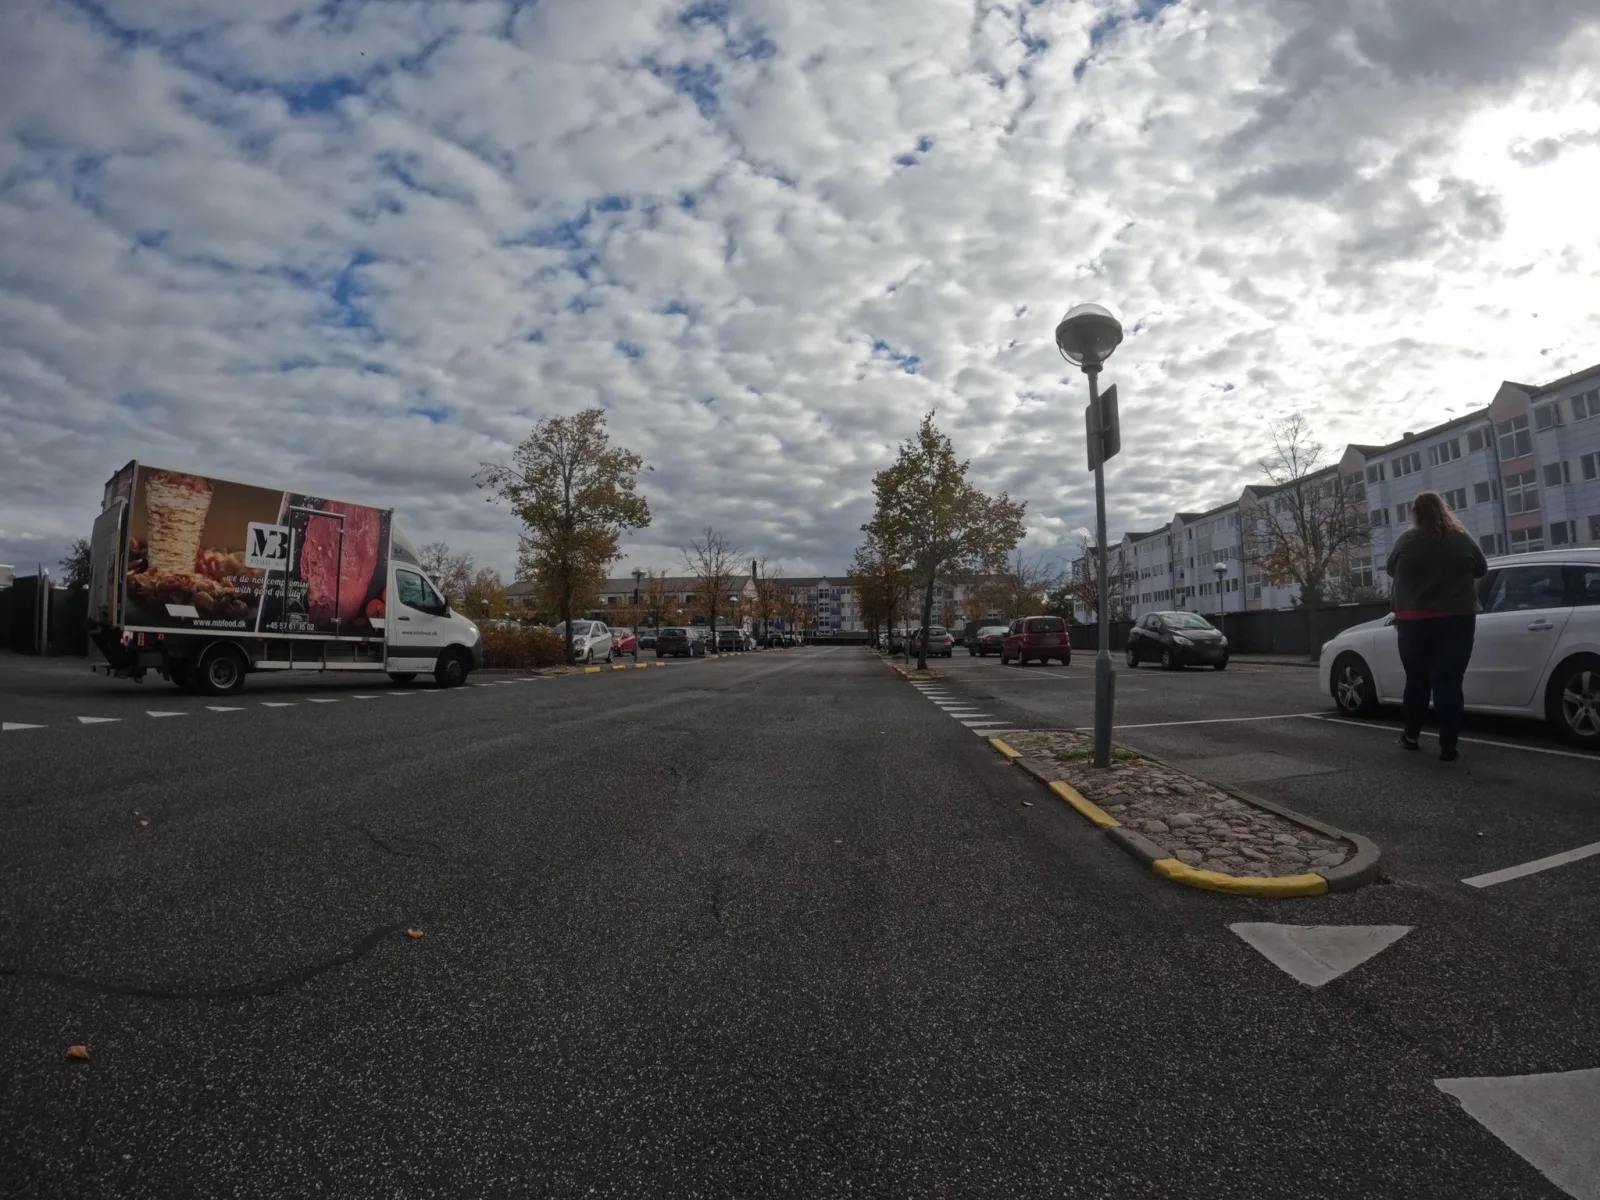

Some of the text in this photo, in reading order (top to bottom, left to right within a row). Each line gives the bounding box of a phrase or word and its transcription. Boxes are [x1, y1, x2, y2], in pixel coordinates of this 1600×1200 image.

[239, 575, 250, 583] do
[266, 578, 309, 589] compomise
[234, 585, 252, 594] with
[254, 587, 273, 597] good
[192, 619, 246, 628] www.mbfood.dk
[265, 621, 278, 630] +45
[306, 623, 315, 631] 02
